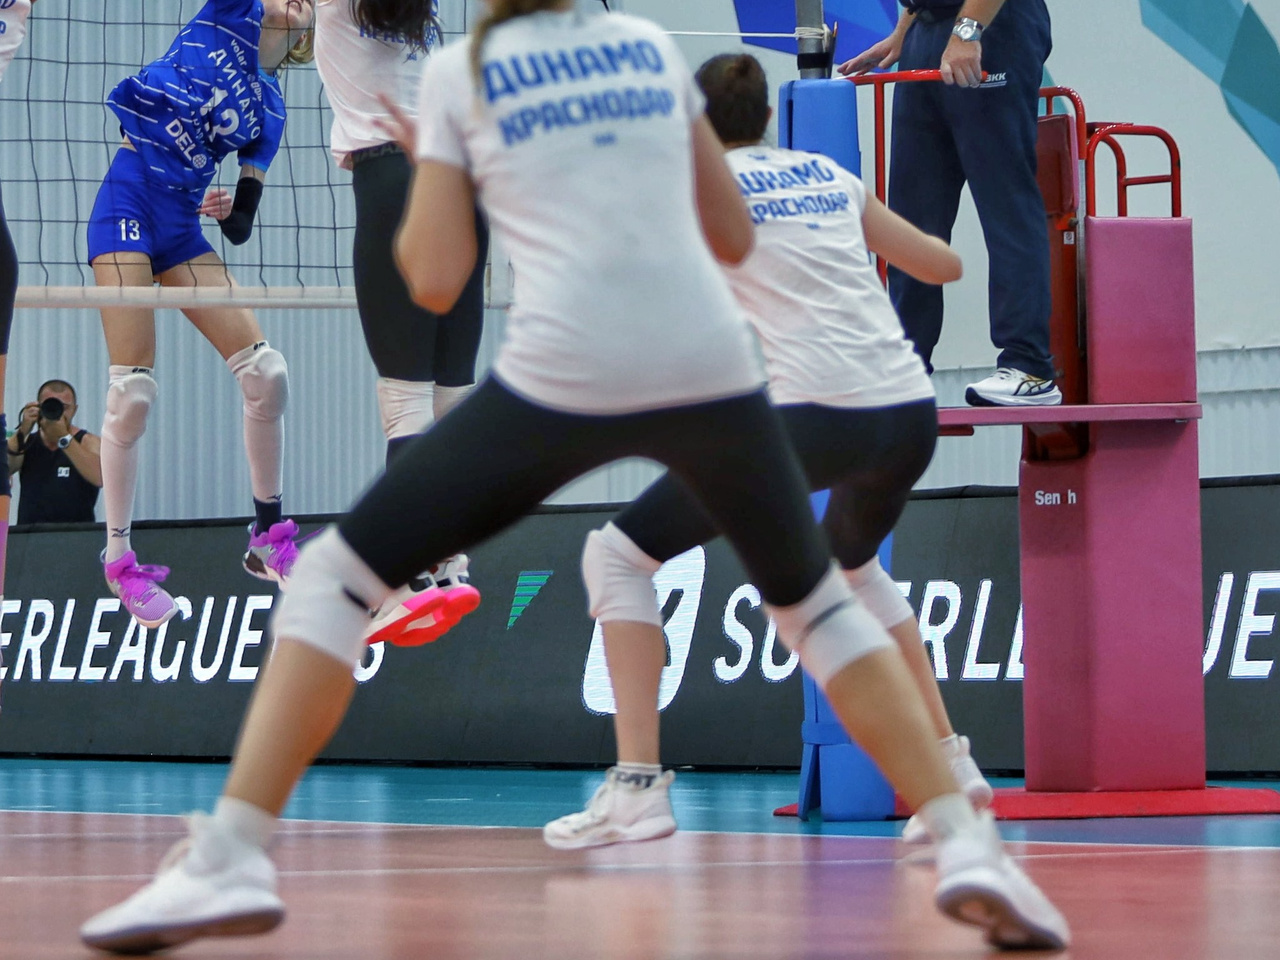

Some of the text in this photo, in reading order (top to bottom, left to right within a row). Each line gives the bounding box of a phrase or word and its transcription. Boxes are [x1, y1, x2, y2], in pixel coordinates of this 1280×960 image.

[231, 39, 248, 66] volar
[481, 38, 665, 104] ДИНАМО
[208, 48, 261, 140] ДИНАМО
[497, 86, 675, 146] КРАСНОДАР
[118, 217, 142, 241] 13
[748, 192, 849, 225] РАСНОДАР
